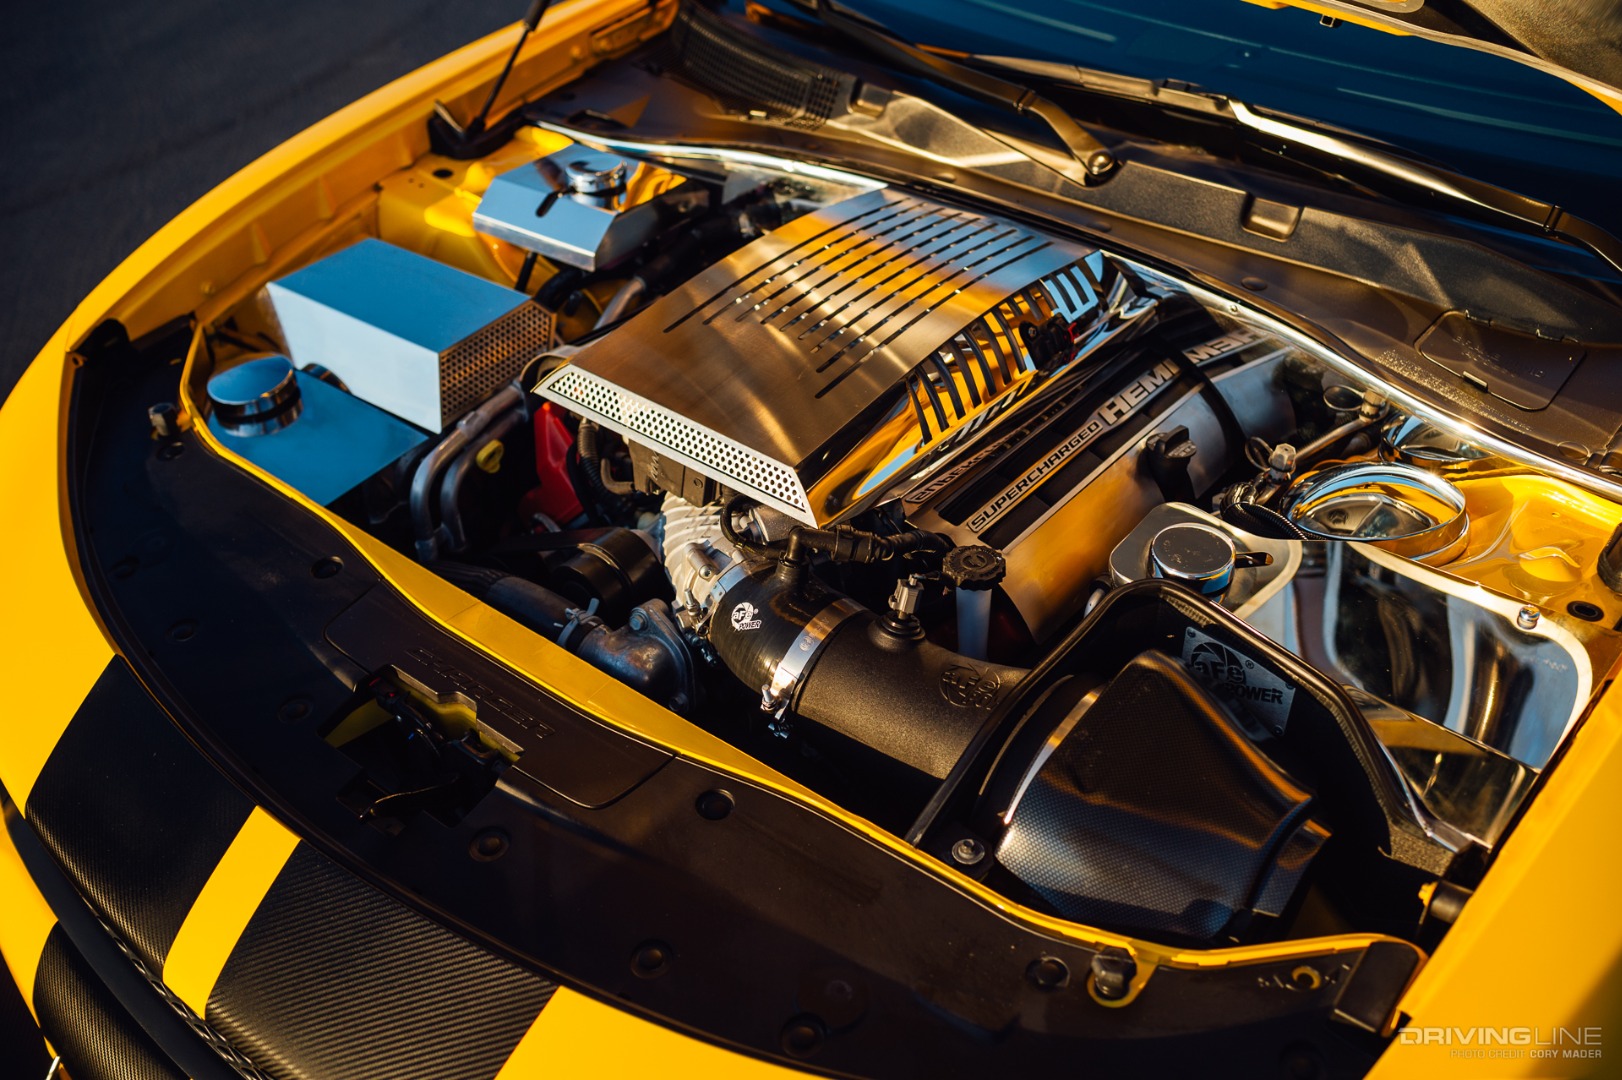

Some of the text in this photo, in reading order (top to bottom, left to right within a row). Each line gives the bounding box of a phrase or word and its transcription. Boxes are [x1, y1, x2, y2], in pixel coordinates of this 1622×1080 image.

[970, 358, 1181, 530] SUPERCHARGED HEMI
[740, 620, 761, 630] POWER
[1192, 660, 1245, 683] aFe
